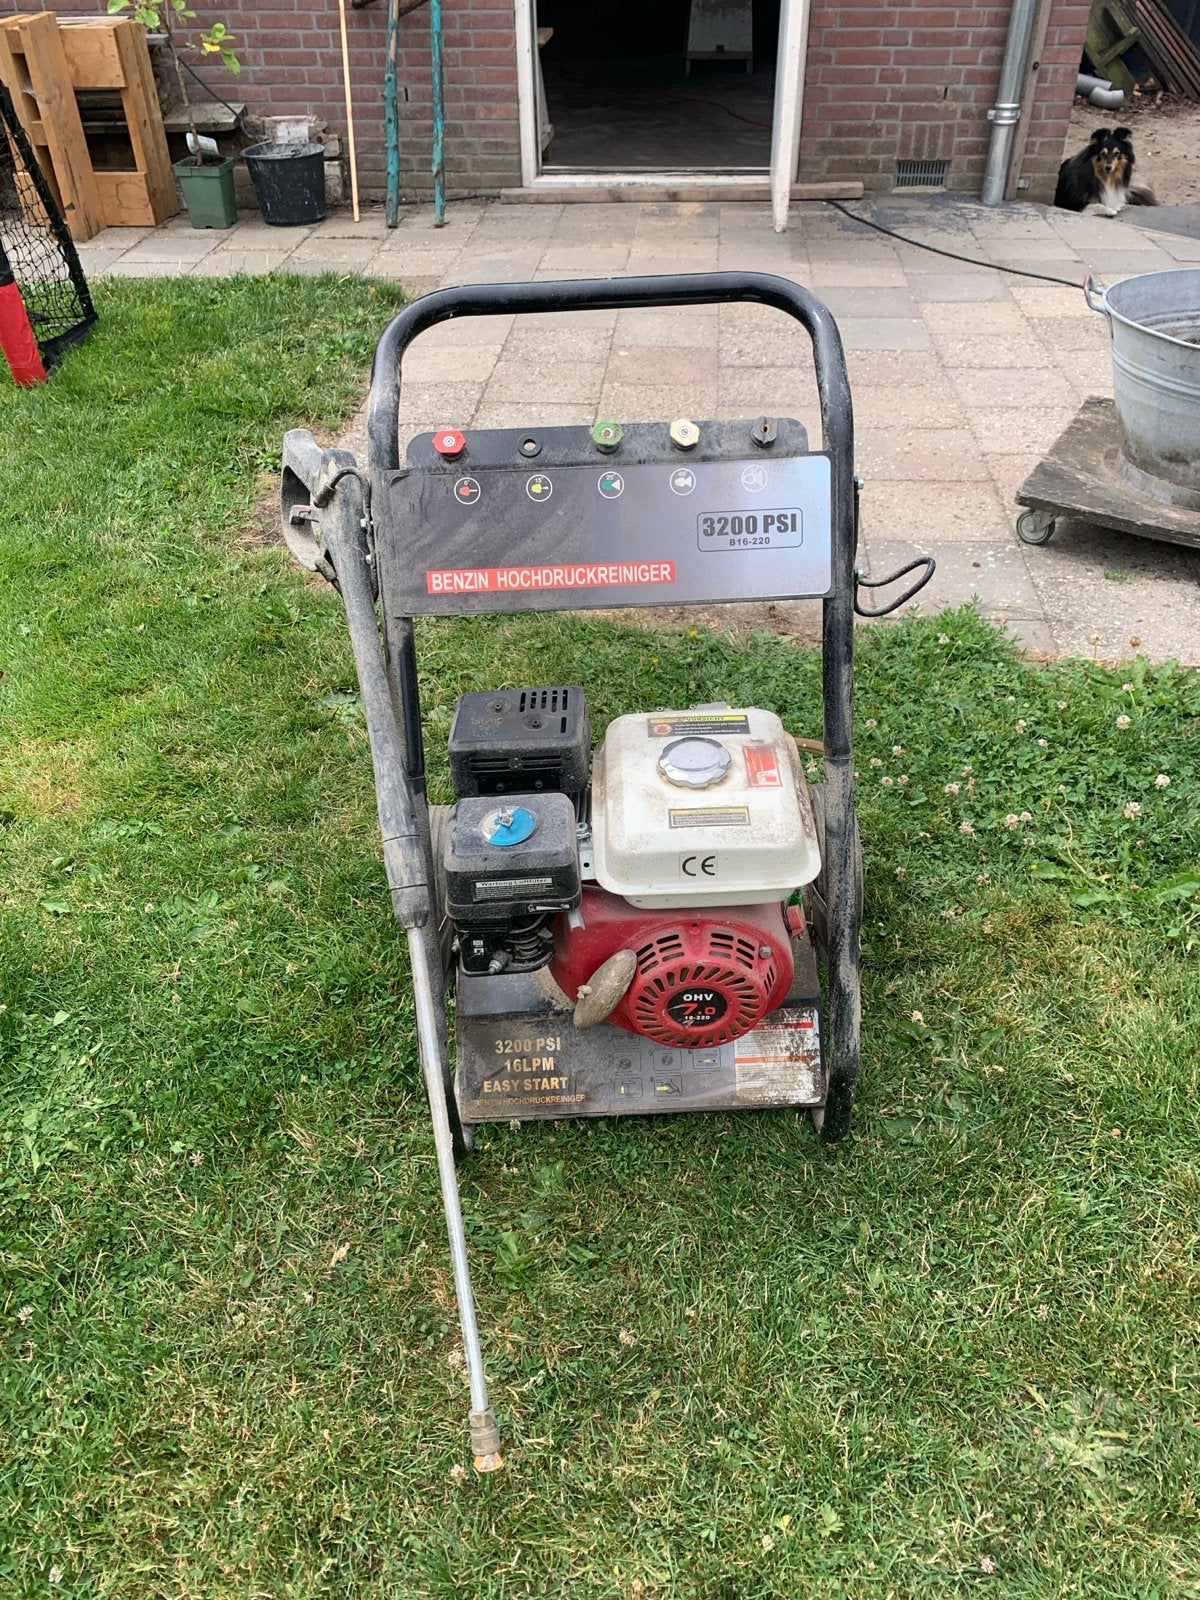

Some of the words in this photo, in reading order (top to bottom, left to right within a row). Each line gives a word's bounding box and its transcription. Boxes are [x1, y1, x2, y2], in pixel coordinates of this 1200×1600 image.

[702, 515, 758, 537] 3200
[763, 513, 797, 534] PSI
[729, 536, 771, 546] B16-220
[431, 571, 489, 591] BENZIN
[497, 563, 672, 588] HOCHDRUCKREINIGER
[681, 855, 716, 877] CE
[683, 993, 714, 1001] OHV
[668, 1002, 716, 1016] 7.0
[494, 1039, 532, 1054] 3200
[536, 1037, 561, 1051] PSI
[504, 1056, 555, 1072] 16LPM
[483, 1079, 520, 1093] EASY
[523, 1077, 568, 1091] START
